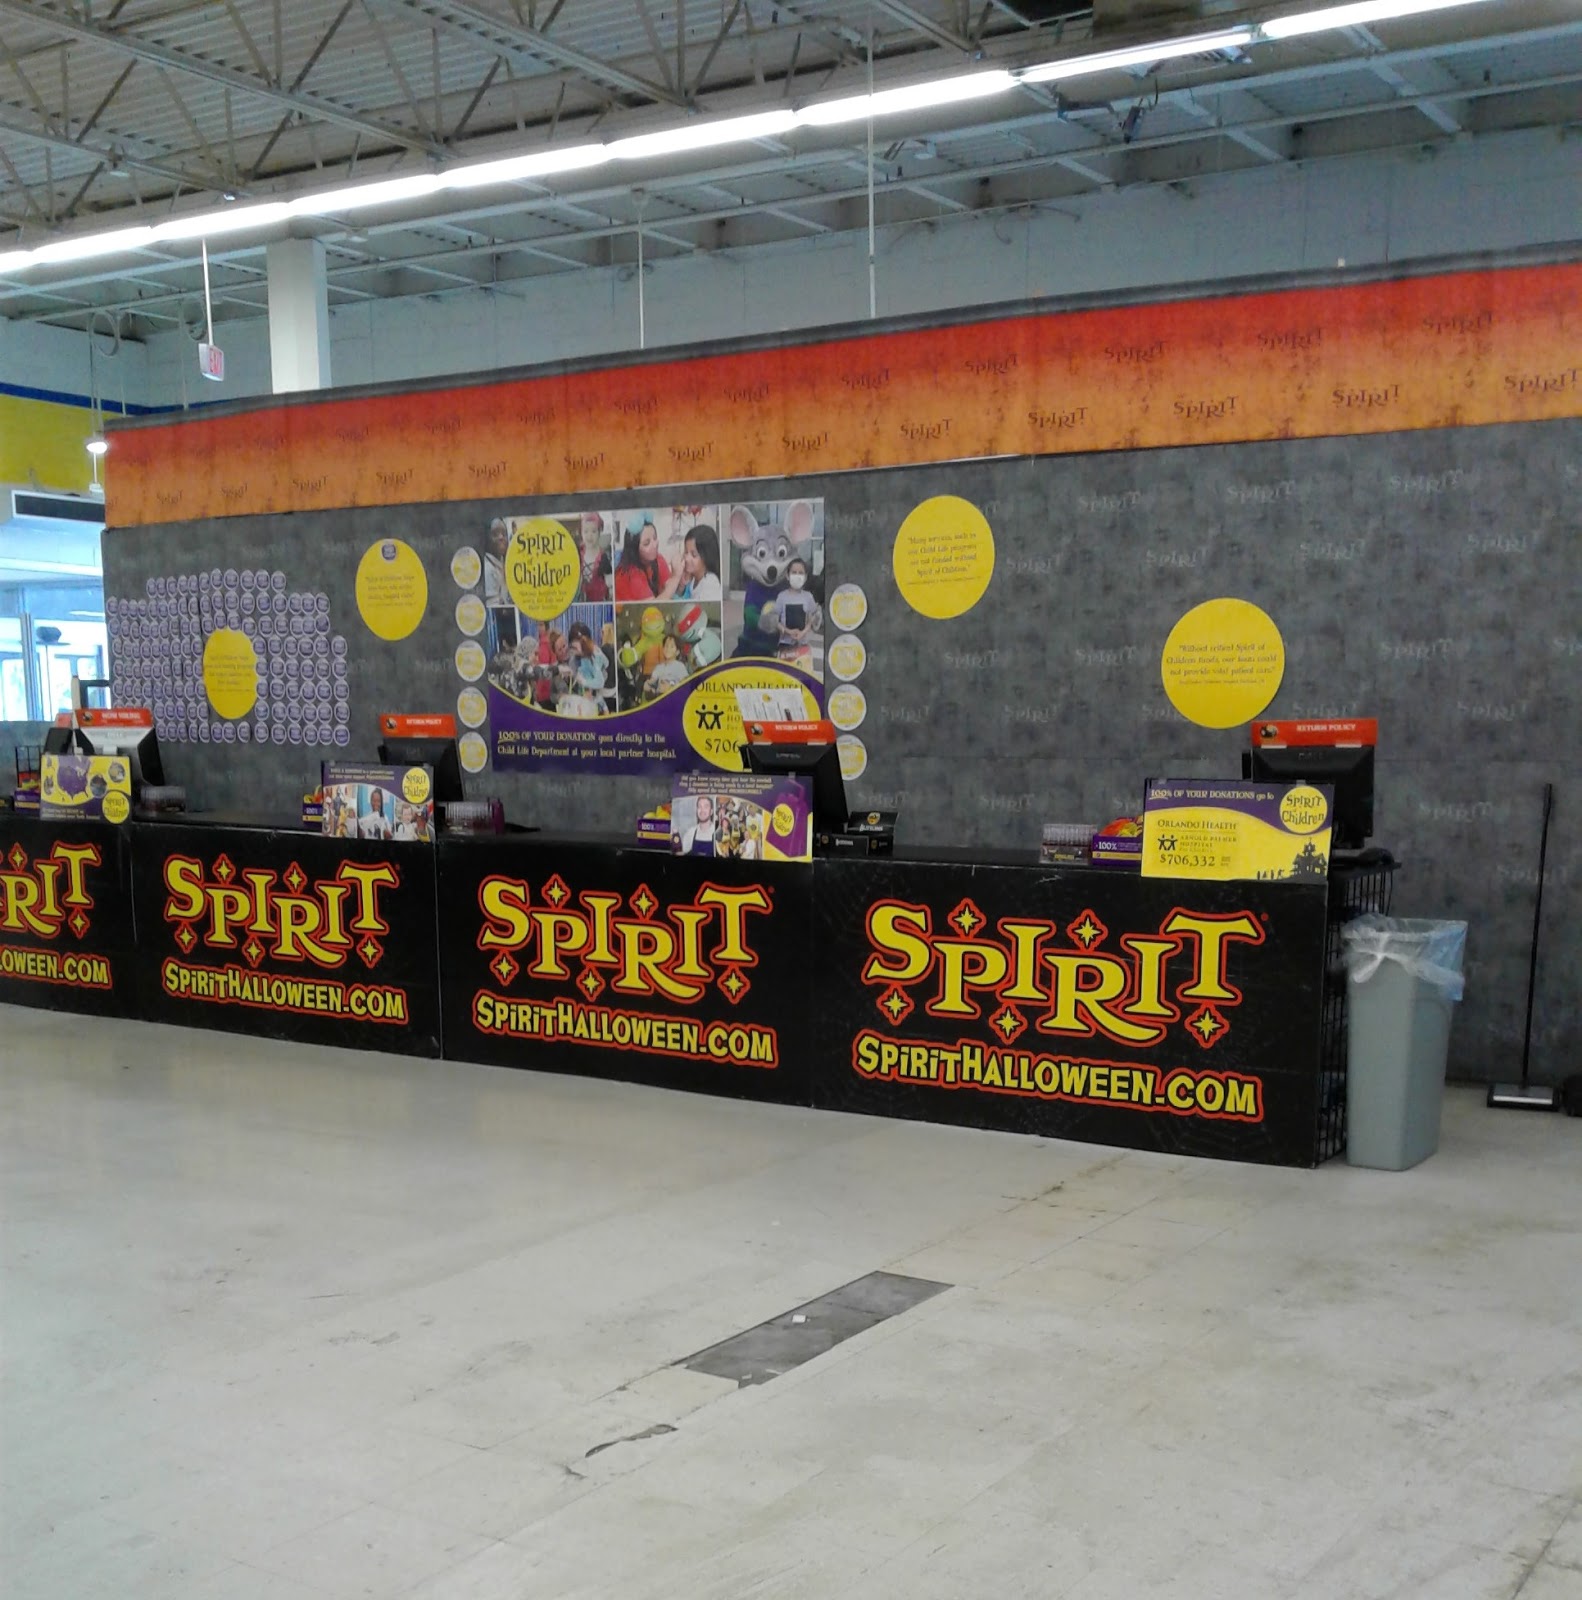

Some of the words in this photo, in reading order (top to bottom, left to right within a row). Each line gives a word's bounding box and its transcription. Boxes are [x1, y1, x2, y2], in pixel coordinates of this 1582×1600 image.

[1258, 328, 1323, 350] SPIRIT
[1104, 341, 1166, 363] SPIRIT
[965, 354, 1017, 374] SPIRIT
[842, 368, 890, 390] SPIRIT
[1504, 368, 1577, 393] SPIRIT
[1332, 384, 1399, 407] SPIRIT
[1173, 396, 1238, 419] SPIRIT
[1028, 407, 1088, 428] SPIRIT
[900, 418, 951, 440] SPIRIT
[782, 432, 828, 451] SPIRIT
[564, 453, 605, 470] SPIRIT
[668, 443, 714, 461] SPIRIT
[469, 461, 507, 478] SPIRIT
[517, 532, 566, 555] SPIRIT
[920, 545, 936, 554] Child
[938, 545, 949, 553] Life
[514, 562, 571, 589] Children
[1236, 643, 1256, 654] Spirit
[1258, 643, 1266, 652] of
[1166, 656, 1196, 665] Children
[1257, 653, 1277, 662] could
[1170, 668, 1181, 676] not
[1184, 667, 1210, 677] provide
[1231, 666, 1254, 676] patient
[1296, 724, 1327, 732] RETURN
[1328, 723, 1356, 731] POLICY
[499, 731, 520, 742] 100%
[522, 731, 532, 741] OF
[533, 731, 555, 741] YOUR
[556, 731, 596, 742] DONATION
[616, 732, 643, 746] directly
[645, 733, 652, 743] to
[655, 733, 666, 743] the
[498, 745, 515, 755] Child
[517, 746, 529, 755] Life
[531, 746, 570, 758] Department
[581, 749, 597, 760] your
[600, 748, 616, 758] local
[618, 748, 644, 760] partner
[646, 748, 677, 761] hospital.
[1151, 789, 1172, 798] 100%
[1173, 789, 1184, 798] OF
[1185, 789, 1208, 799] YOUR
[1209, 790, 1256, 799] DONATIONS
[1256, 793, 1265, 801] go
[1266, 792, 1275, 800] to
[1285, 794, 1323, 809] SPIRIT
[1157, 819, 1200, 829] ORLANDO
[1201, 820, 1237, 830] HEALTH
[1281, 810, 1325, 827] Children
[1098, 841, 1117, 851] 100%
[1160, 853, 1215, 867] $706,332
[0, 845, 99, 935] RIT
[165, 856, 397, 966] SPIRIT
[479, 876, 771, 1001] SPIRIT
[0, 948, 109, 985] OWEEN.COM
[863, 900, 1263, 1044] SPIRIT
